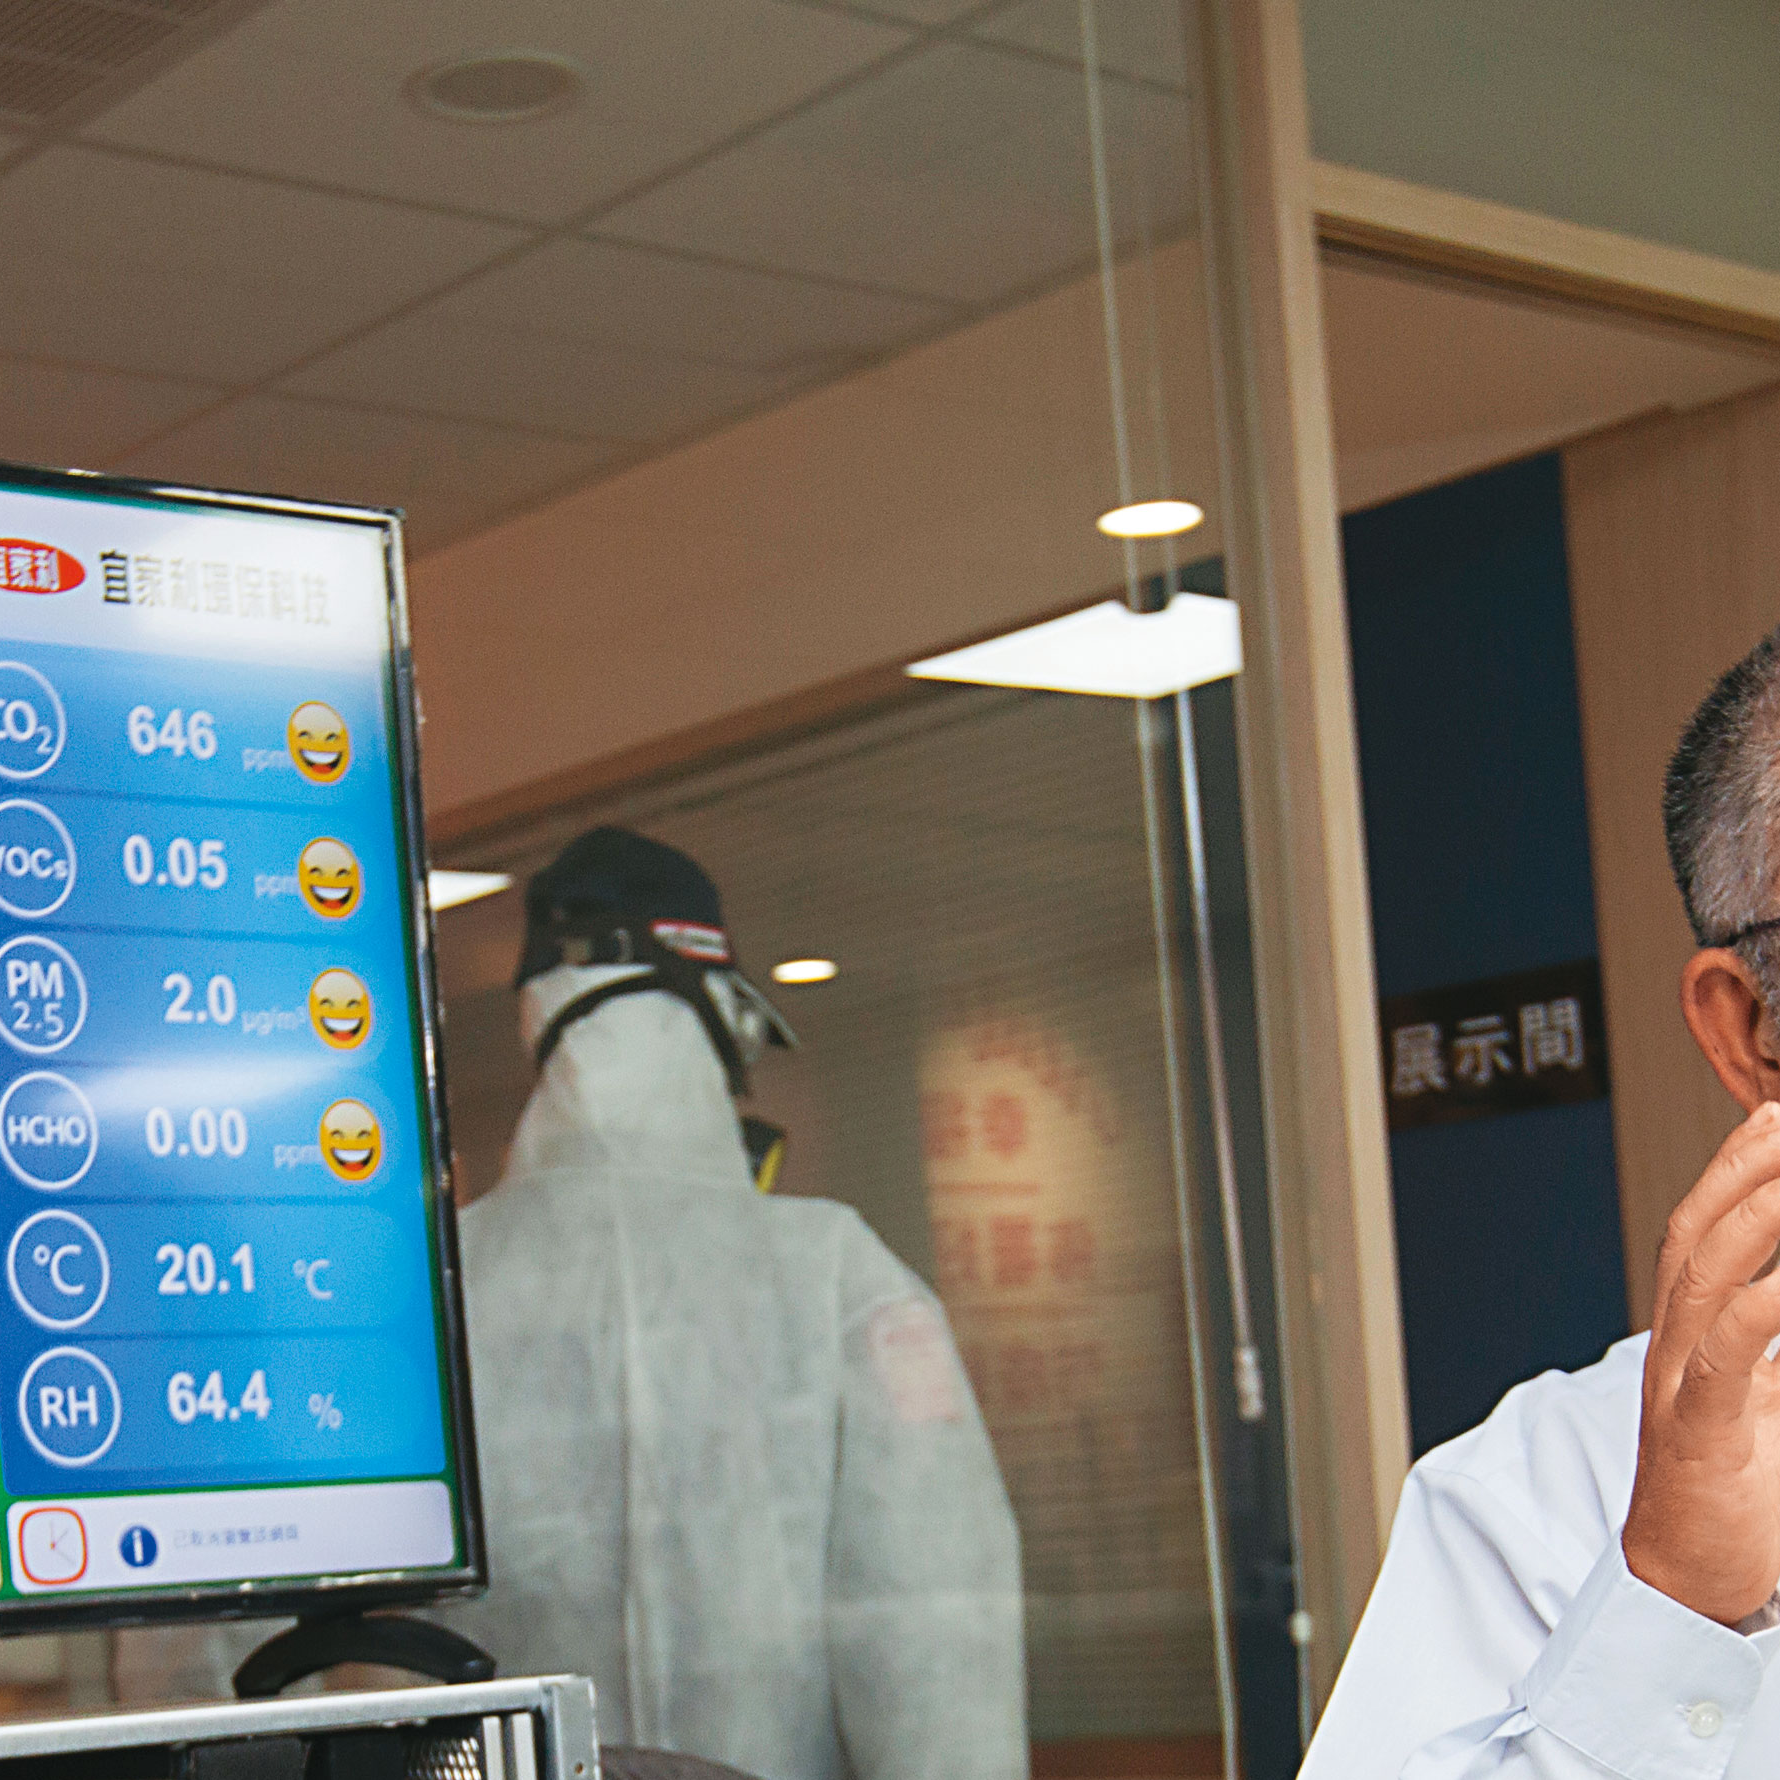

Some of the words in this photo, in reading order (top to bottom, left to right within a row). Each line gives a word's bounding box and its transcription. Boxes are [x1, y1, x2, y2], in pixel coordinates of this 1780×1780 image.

[126, 704, 218, 761] 646
[122, 834, 229, 889] 0.05
[6, 958, 65, 1000] PM
[162, 972, 237, 1025] 2.0
[13, 1000, 65, 1039] 2.5
[7, 1114, 88, 1147] HCHO
[145, 1105, 249, 1159] 0.00
[155, 1241, 256, 1296] 20.1
[39, 1385, 99, 1428] RH
[167, 1368, 272, 1425] 64.4
[308, 1392, 344, 1430] %
